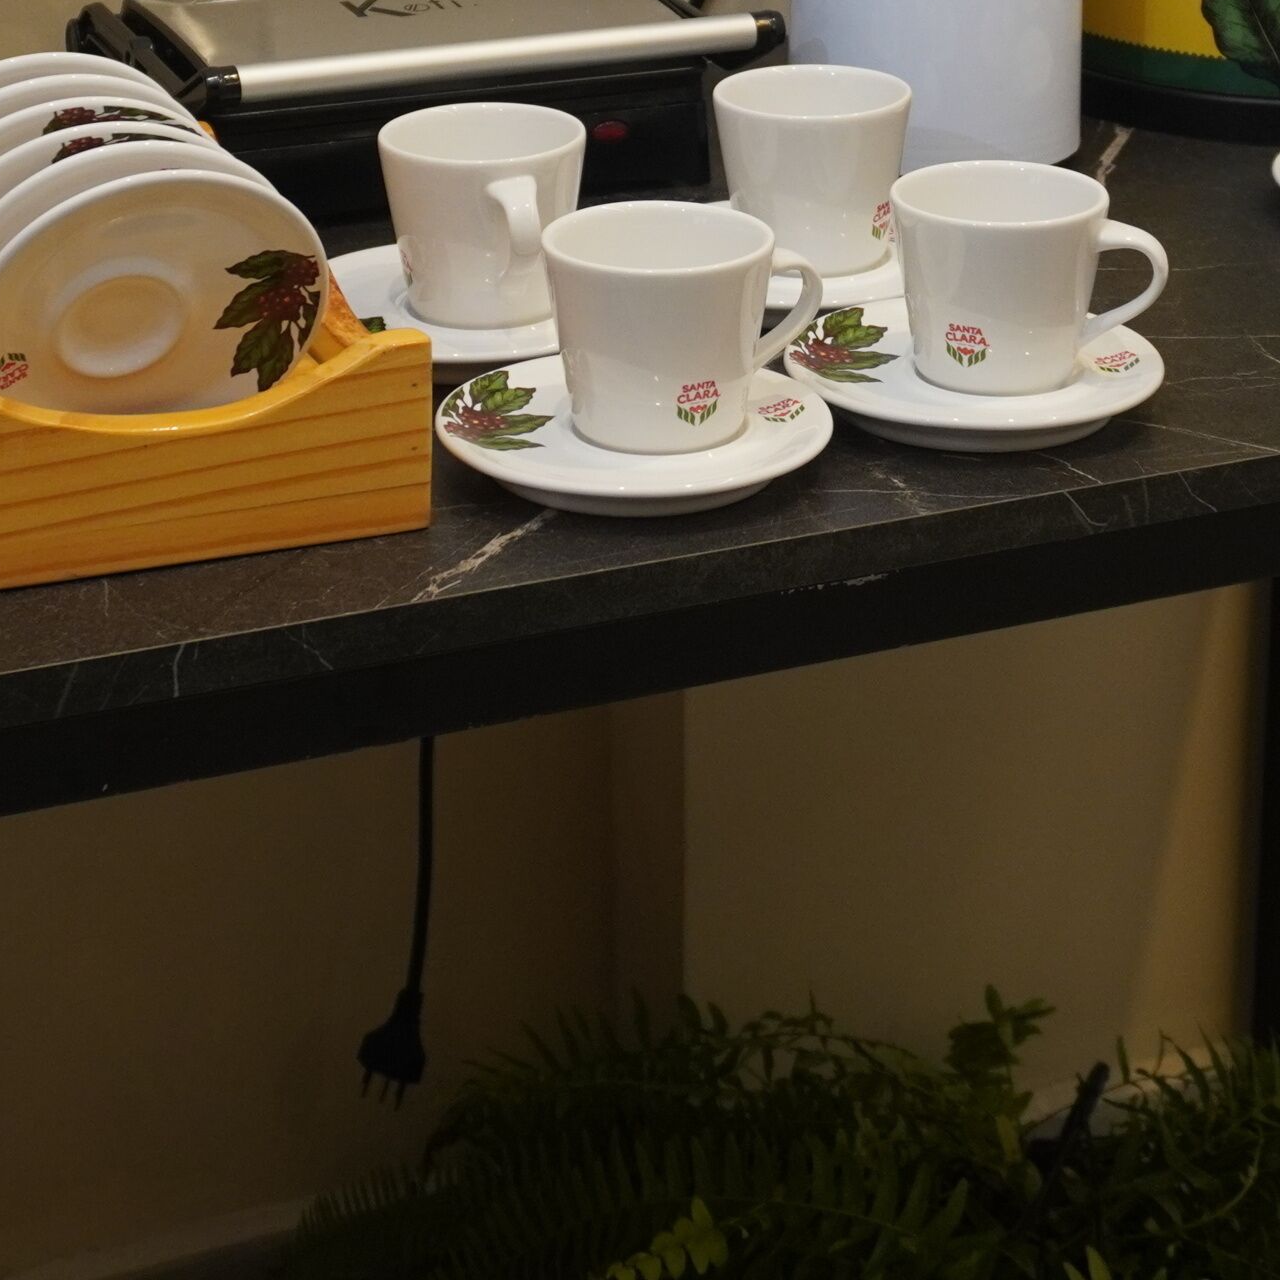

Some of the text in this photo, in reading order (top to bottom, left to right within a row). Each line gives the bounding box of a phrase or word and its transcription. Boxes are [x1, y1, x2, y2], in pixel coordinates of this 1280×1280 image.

[949, 323, 983, 336] SANTA
[946, 332, 987, 347] CLARA
[682, 380, 716, 393] SANTA
[677, 388, 719, 404] CLARA
